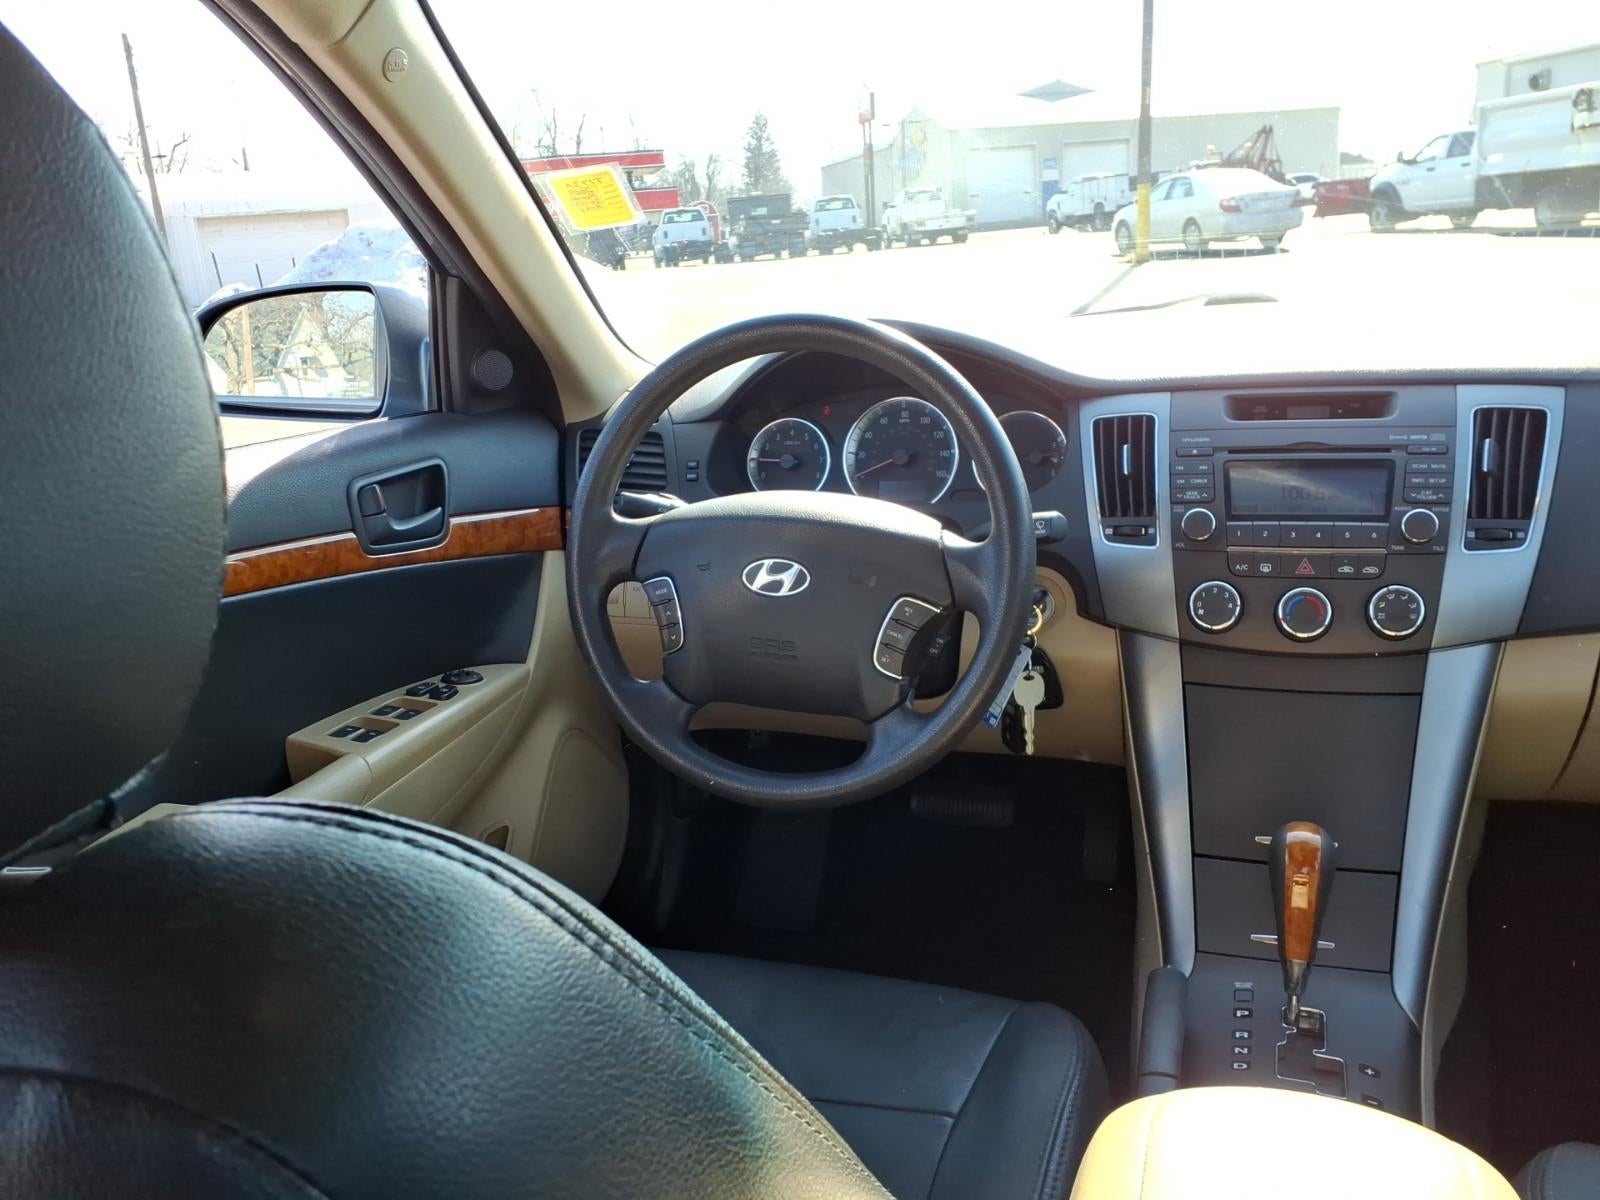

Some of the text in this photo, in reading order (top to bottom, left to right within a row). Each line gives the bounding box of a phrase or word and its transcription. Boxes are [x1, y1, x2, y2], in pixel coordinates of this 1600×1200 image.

[864, 431, 873, 439] 40
[933, 431, 944, 439] 120
[936, 470, 947, 478] 160
[1235, 563, 1249, 571] A/C
[1236, 1009, 1249, 1017] P
[1235, 1030, 1249, 1039] R
[1233, 1062, 1248, 1070] D
